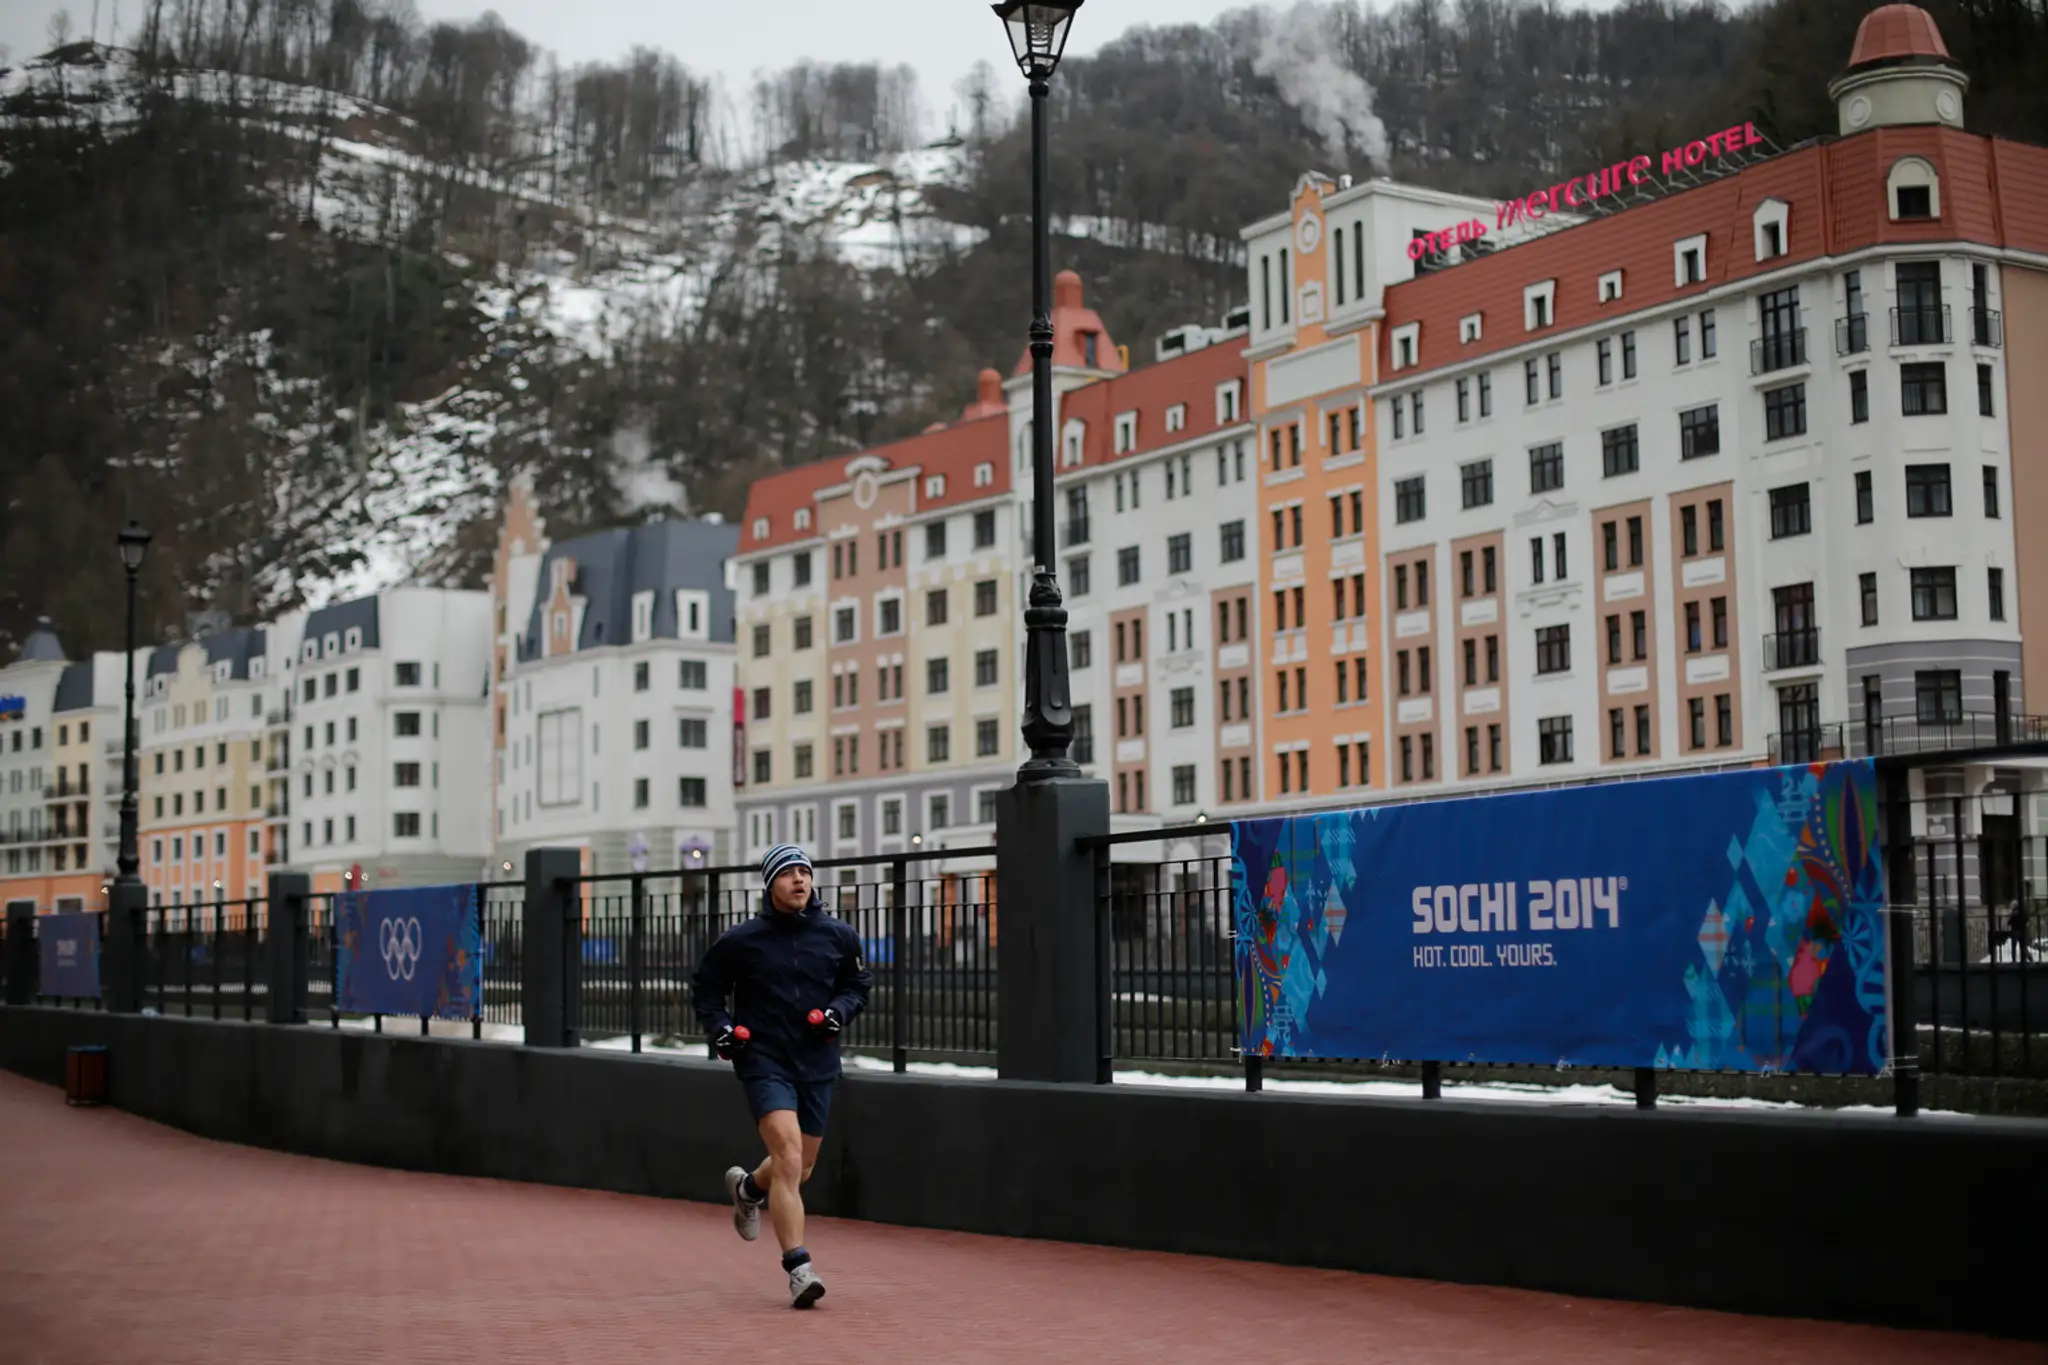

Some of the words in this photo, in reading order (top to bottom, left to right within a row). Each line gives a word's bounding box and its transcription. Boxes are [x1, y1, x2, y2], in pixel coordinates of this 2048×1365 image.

[1661, 121, 1763, 176] HOTEL
[1412, 882, 1517, 934] SOCHI
[1413, 946, 1447, 968] HOT.
[1450, 945, 1493, 967] COOL.
[1496, 943, 1557, 967] YOURS.
